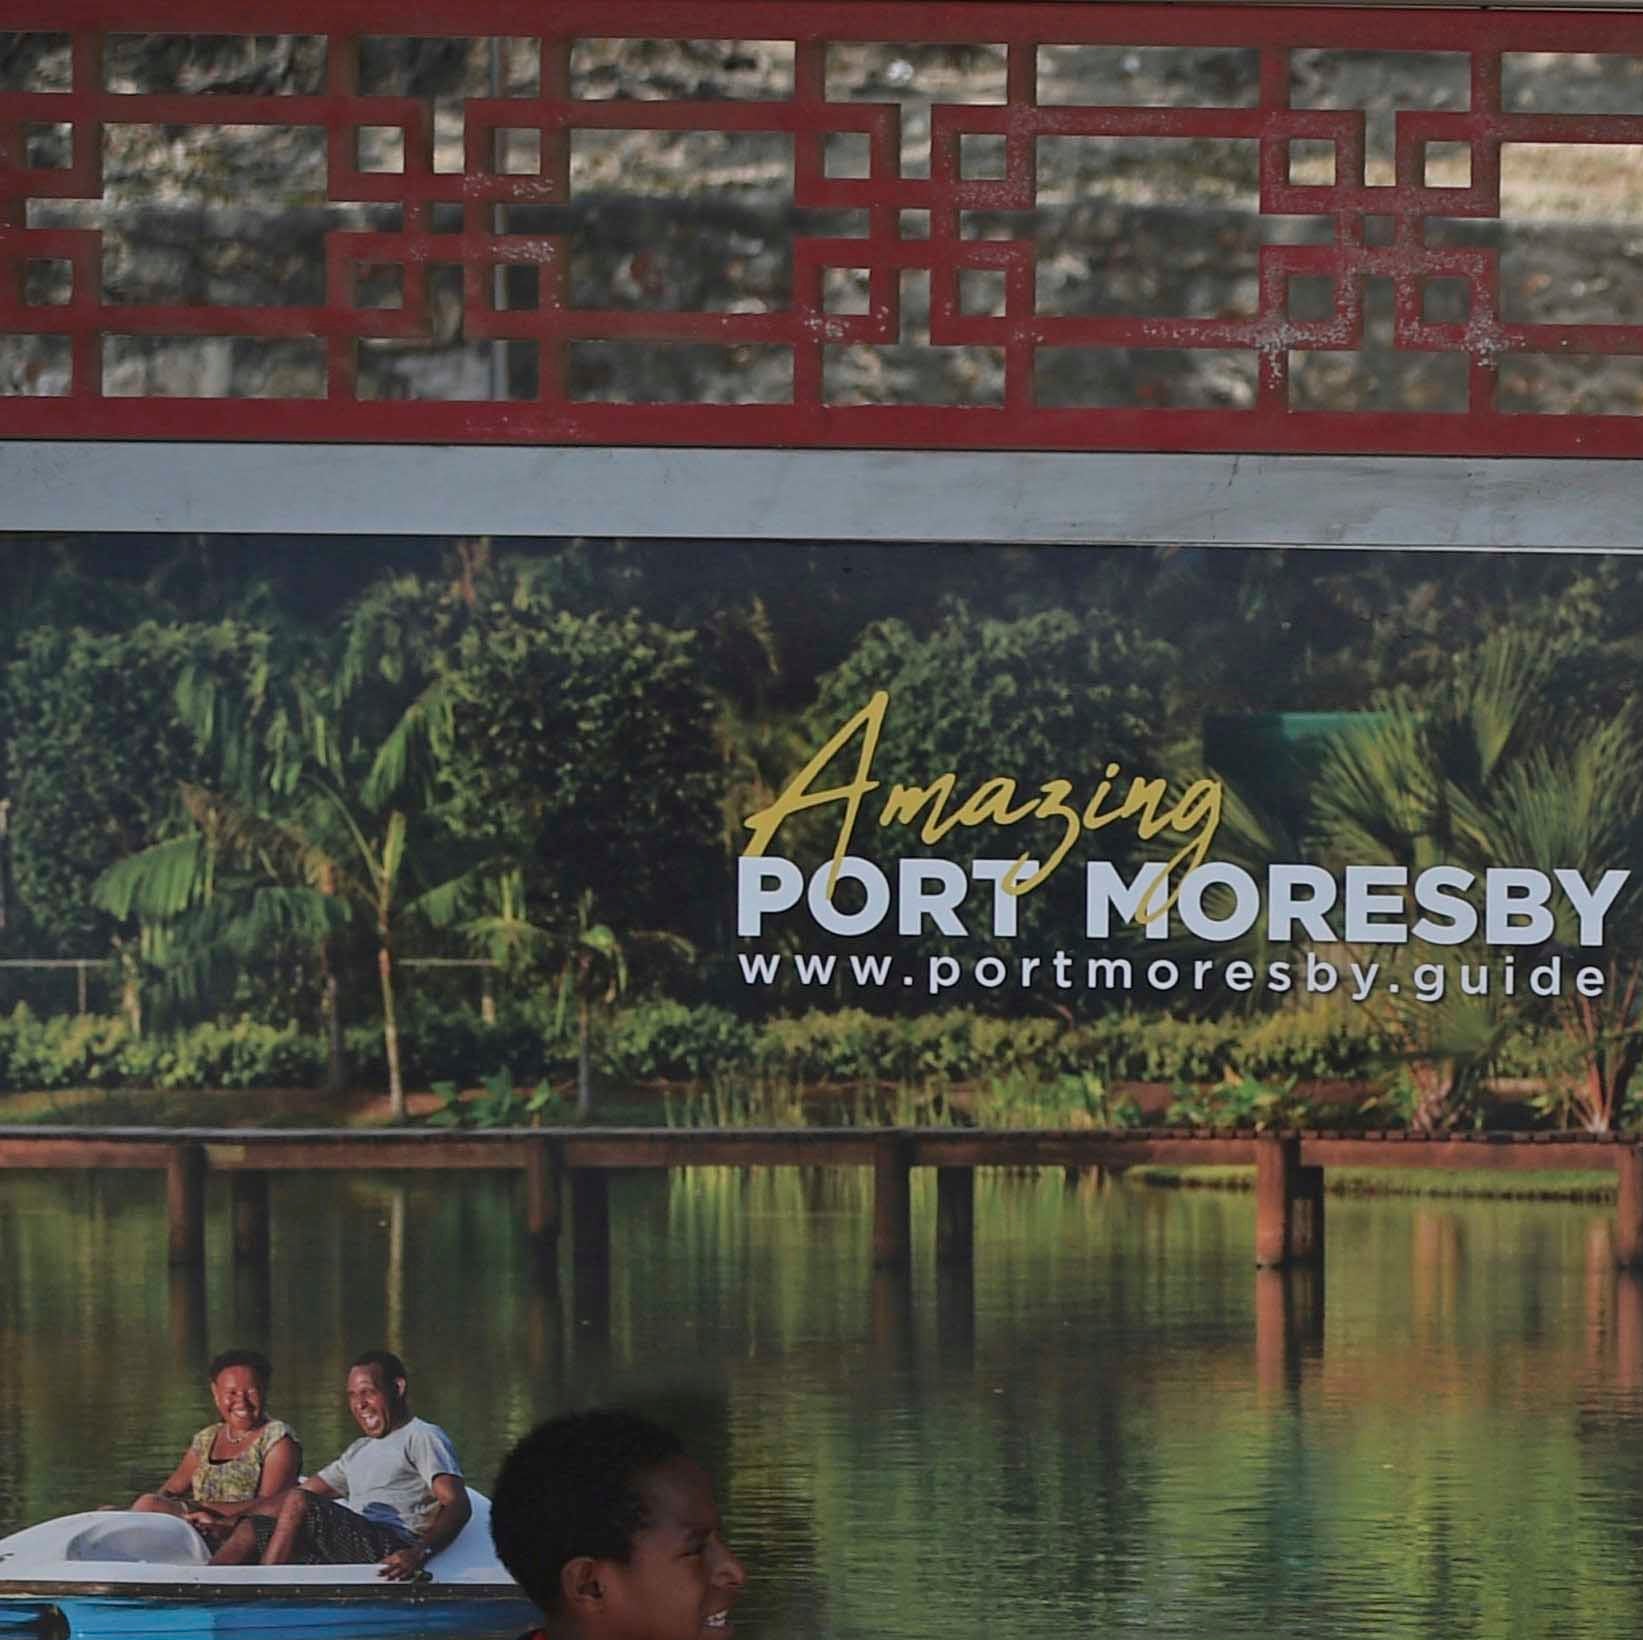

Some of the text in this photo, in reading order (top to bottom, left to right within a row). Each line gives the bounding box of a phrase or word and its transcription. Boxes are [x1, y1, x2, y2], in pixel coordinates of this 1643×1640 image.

[742, 690, 1223, 926] Amazing
[736, 855, 1632, 947] PORT MORESBY
[737, 949, 1607, 1003] www.portmoresby.guide
